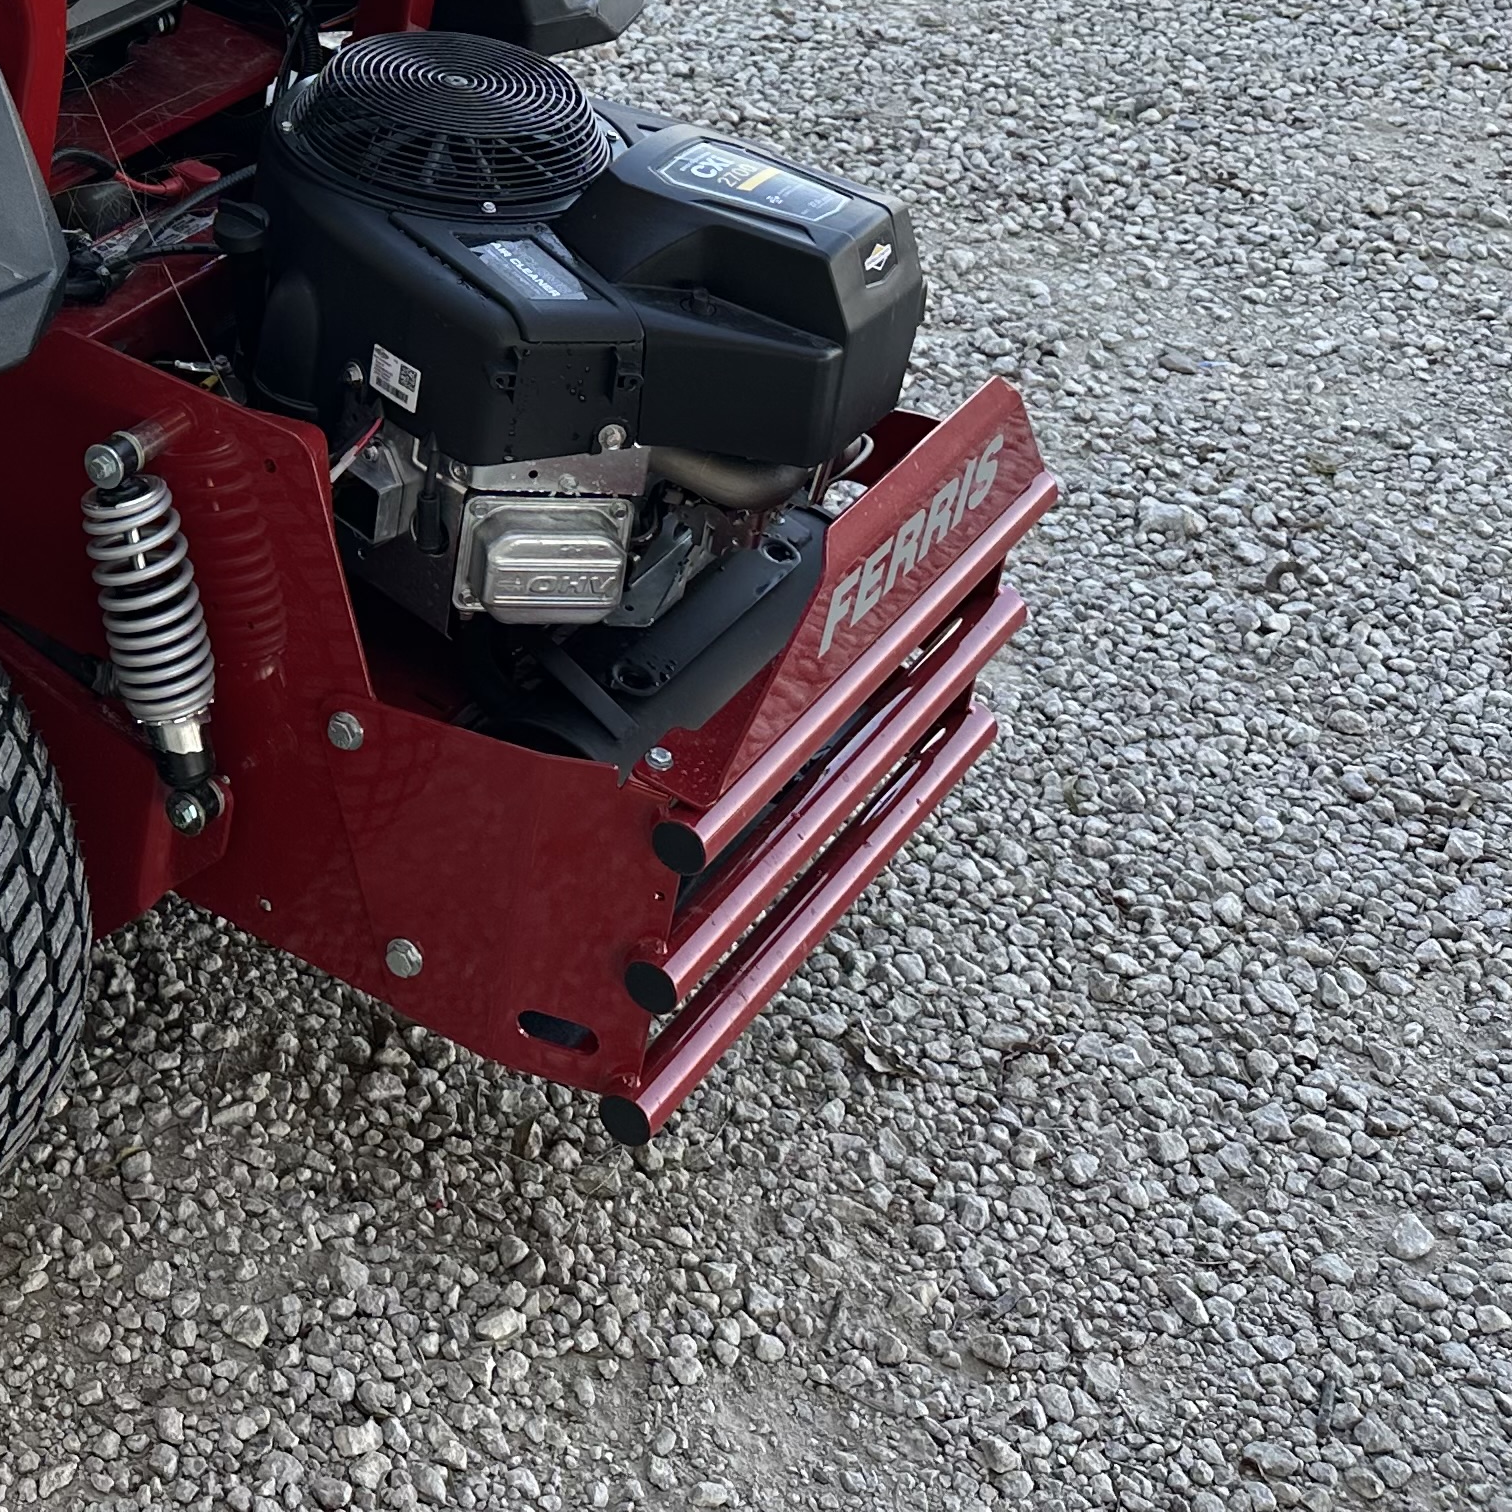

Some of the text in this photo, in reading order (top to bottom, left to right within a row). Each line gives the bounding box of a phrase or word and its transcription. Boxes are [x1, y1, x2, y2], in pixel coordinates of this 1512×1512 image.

[717, 163, 757, 188] 2700
[509, 258, 561, 297] CLEANER
[818, 433, 1004, 659] FERRIS
[528, 575, 616, 595] OHV
